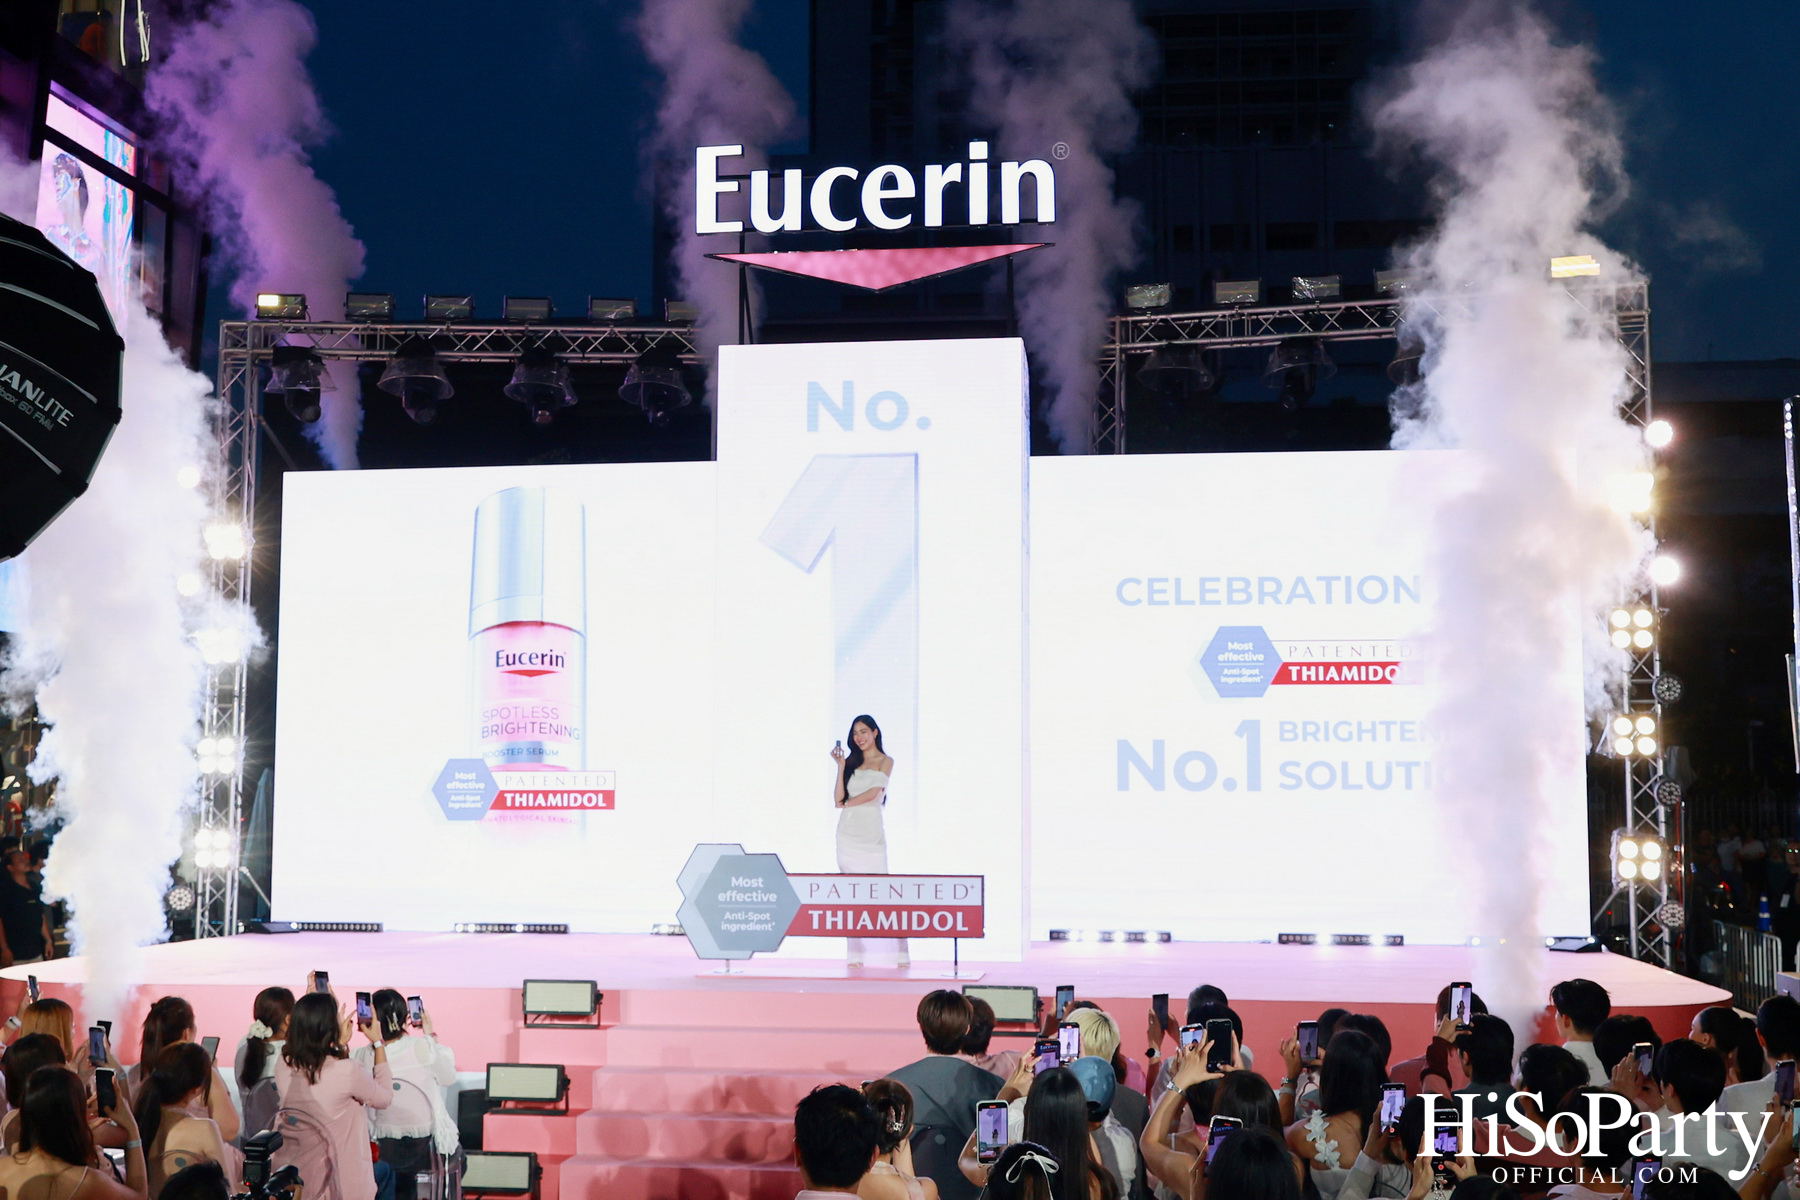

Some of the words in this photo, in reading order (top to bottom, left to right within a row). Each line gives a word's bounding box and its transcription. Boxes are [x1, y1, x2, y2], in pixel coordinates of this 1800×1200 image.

[806, 379, 932, 433] No.
[1115, 574, 1422, 607] CELEBRATION
[1227, 641, 1255, 651] Most
[1217, 651, 1265, 662] effective
[482, 705, 560, 723] SPOTLESS
[481, 721, 581, 741] BRIGHTENING
[526, 747, 560, 757] SERUM
[1115, 718, 1263, 793] No.1
[1278, 720, 1447, 743] BRIGHTEN
[504, 775, 608, 787] PATENTED
[504, 792, 607, 807] THIAMIDOL
[731, 875, 764, 888] Most
[717, 889, 778, 903] effective
[724, 910, 771, 922] Anti-Spot
[807, 908, 969, 932] THIAMIDOL
